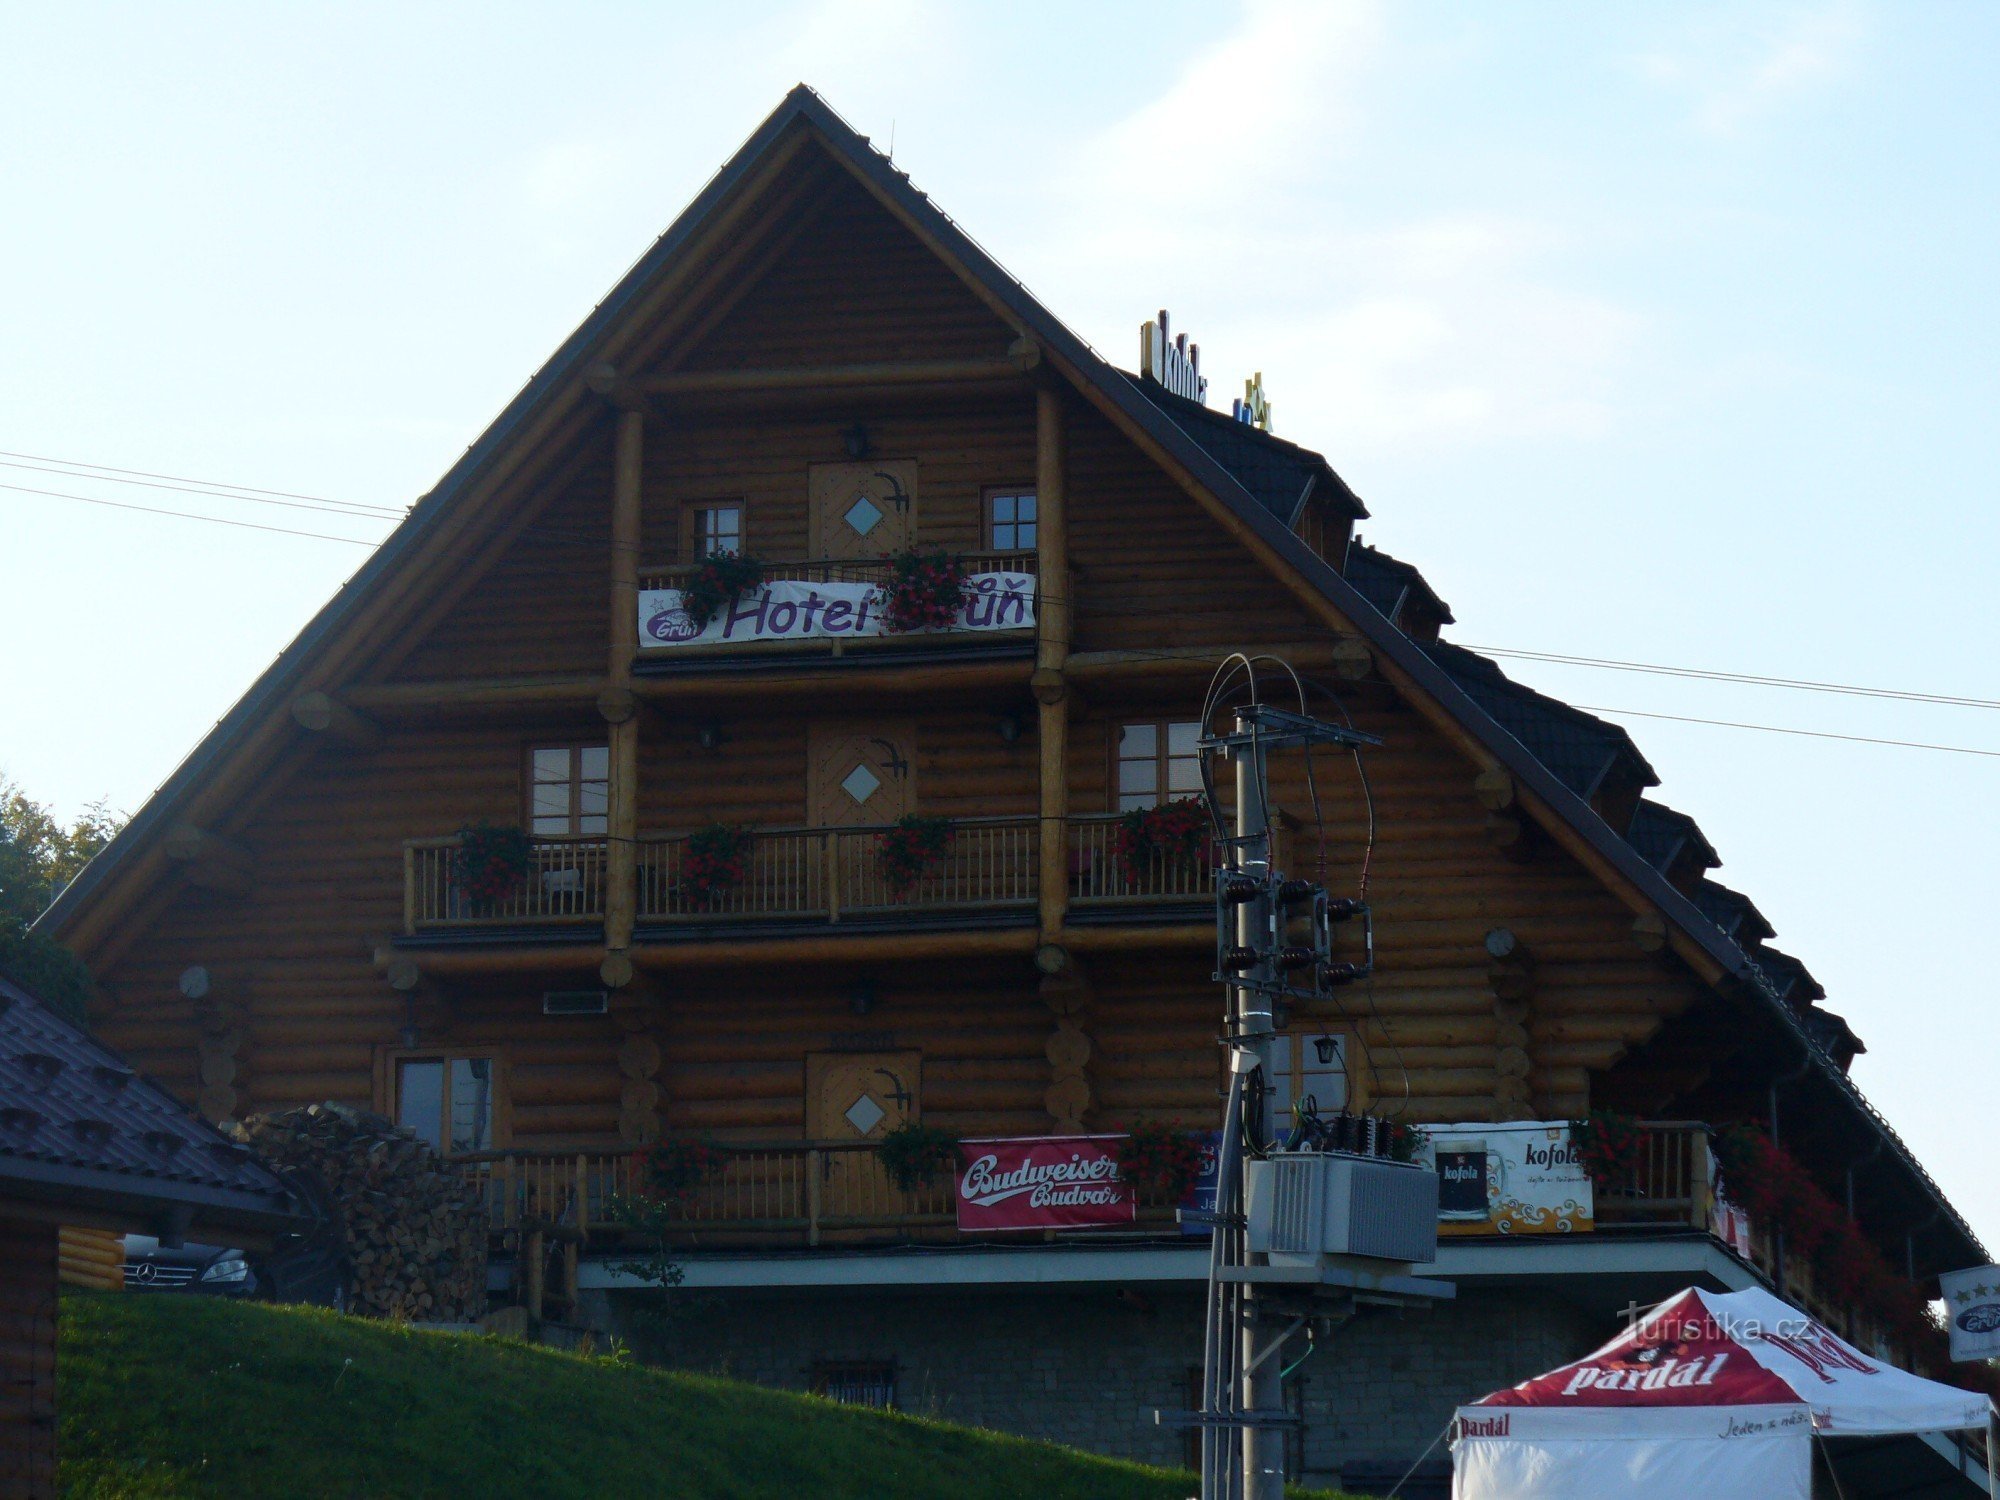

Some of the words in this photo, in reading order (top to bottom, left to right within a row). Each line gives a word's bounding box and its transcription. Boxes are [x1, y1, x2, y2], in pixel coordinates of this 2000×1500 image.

[723, 588, 875, 639] Hotel
[1525, 1143, 1582, 1170] kofola
[961, 1154, 1120, 1199] Budweiser
[1444, 1165, 1478, 1183] kofola
[1029, 1181, 1122, 1208] Budvar
[1561, 1352, 1729, 1396] pardál
[1460, 1412, 1510, 1438] pardál
[1719, 1416, 1763, 1439] Jeden
